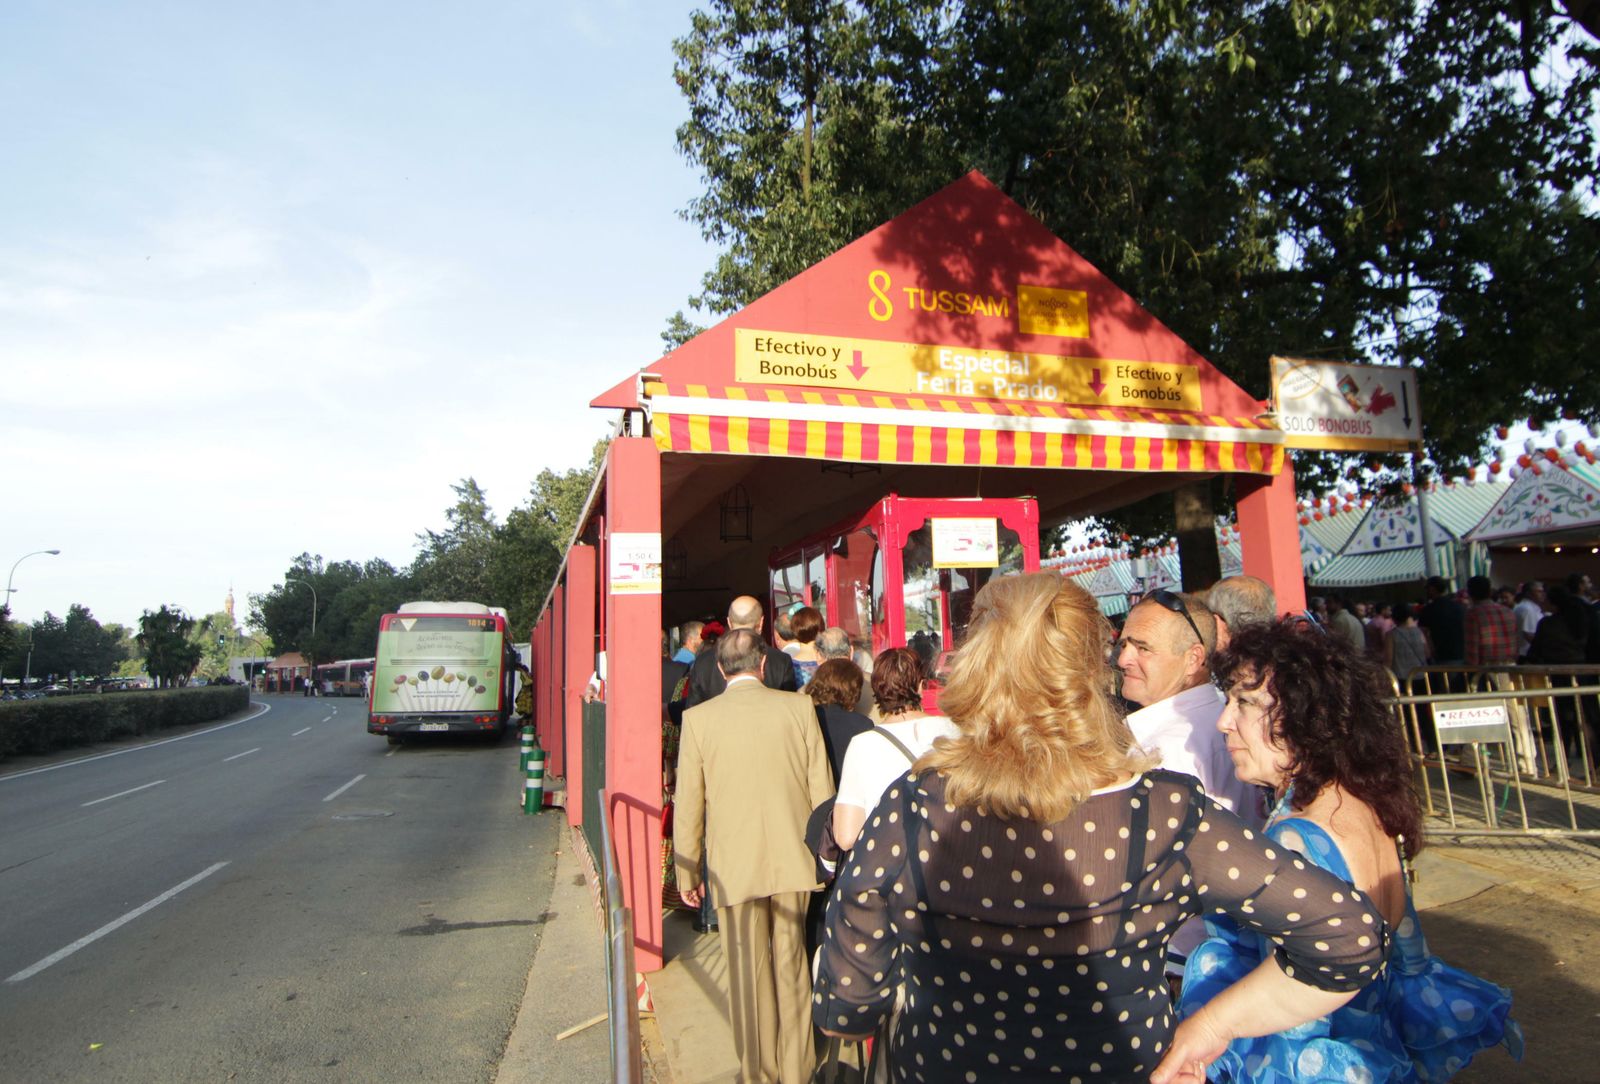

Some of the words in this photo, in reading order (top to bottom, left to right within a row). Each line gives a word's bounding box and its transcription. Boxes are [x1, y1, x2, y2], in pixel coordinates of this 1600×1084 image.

[903, 287, 1009, 318] TUSSAM
[755, 337, 827, 357] Efectivo
[832, 347, 841, 361] y
[760, 360, 837, 379] Bonobús
[939, 349, 1029, 377] Especial
[1116, 365, 1172, 382] Efectivo
[1175, 372, 1183, 385] y
[916, 371, 974, 395] Feria
[993, 376, 1058, 400] Prado
[1121, 385, 1182, 401] Bonobús
[1285, 416, 1315, 432] SOLO
[1318, 416, 1373, 435] BONOBÚS
[1448, 708, 1502, 720] REMSA
